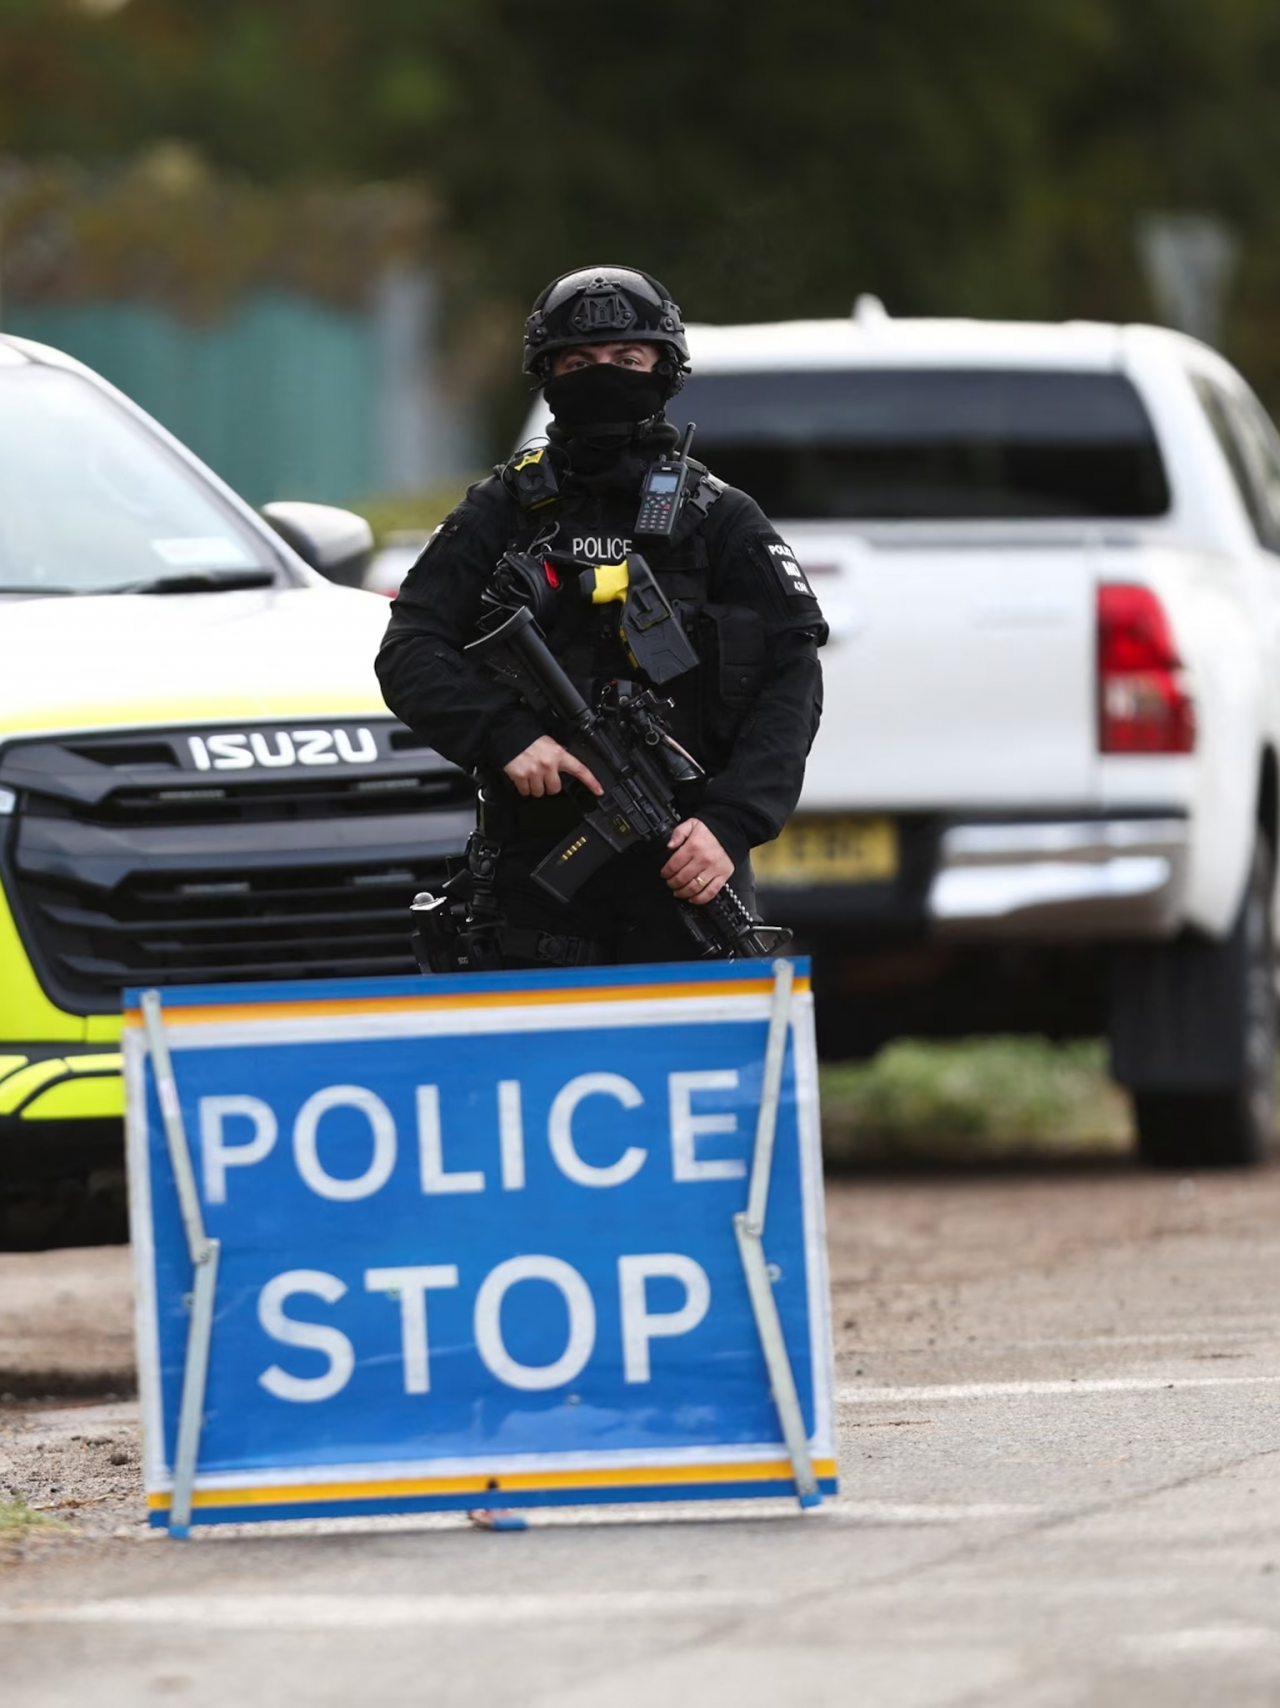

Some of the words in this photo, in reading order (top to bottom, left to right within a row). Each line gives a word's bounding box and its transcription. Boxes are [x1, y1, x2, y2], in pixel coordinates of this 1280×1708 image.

[572, 536, 633, 560] POLICE
[187, 727, 379, 771] ISUZU
[198, 1070, 747, 1204] POLICE
[257, 1253, 712, 1404] STOP
